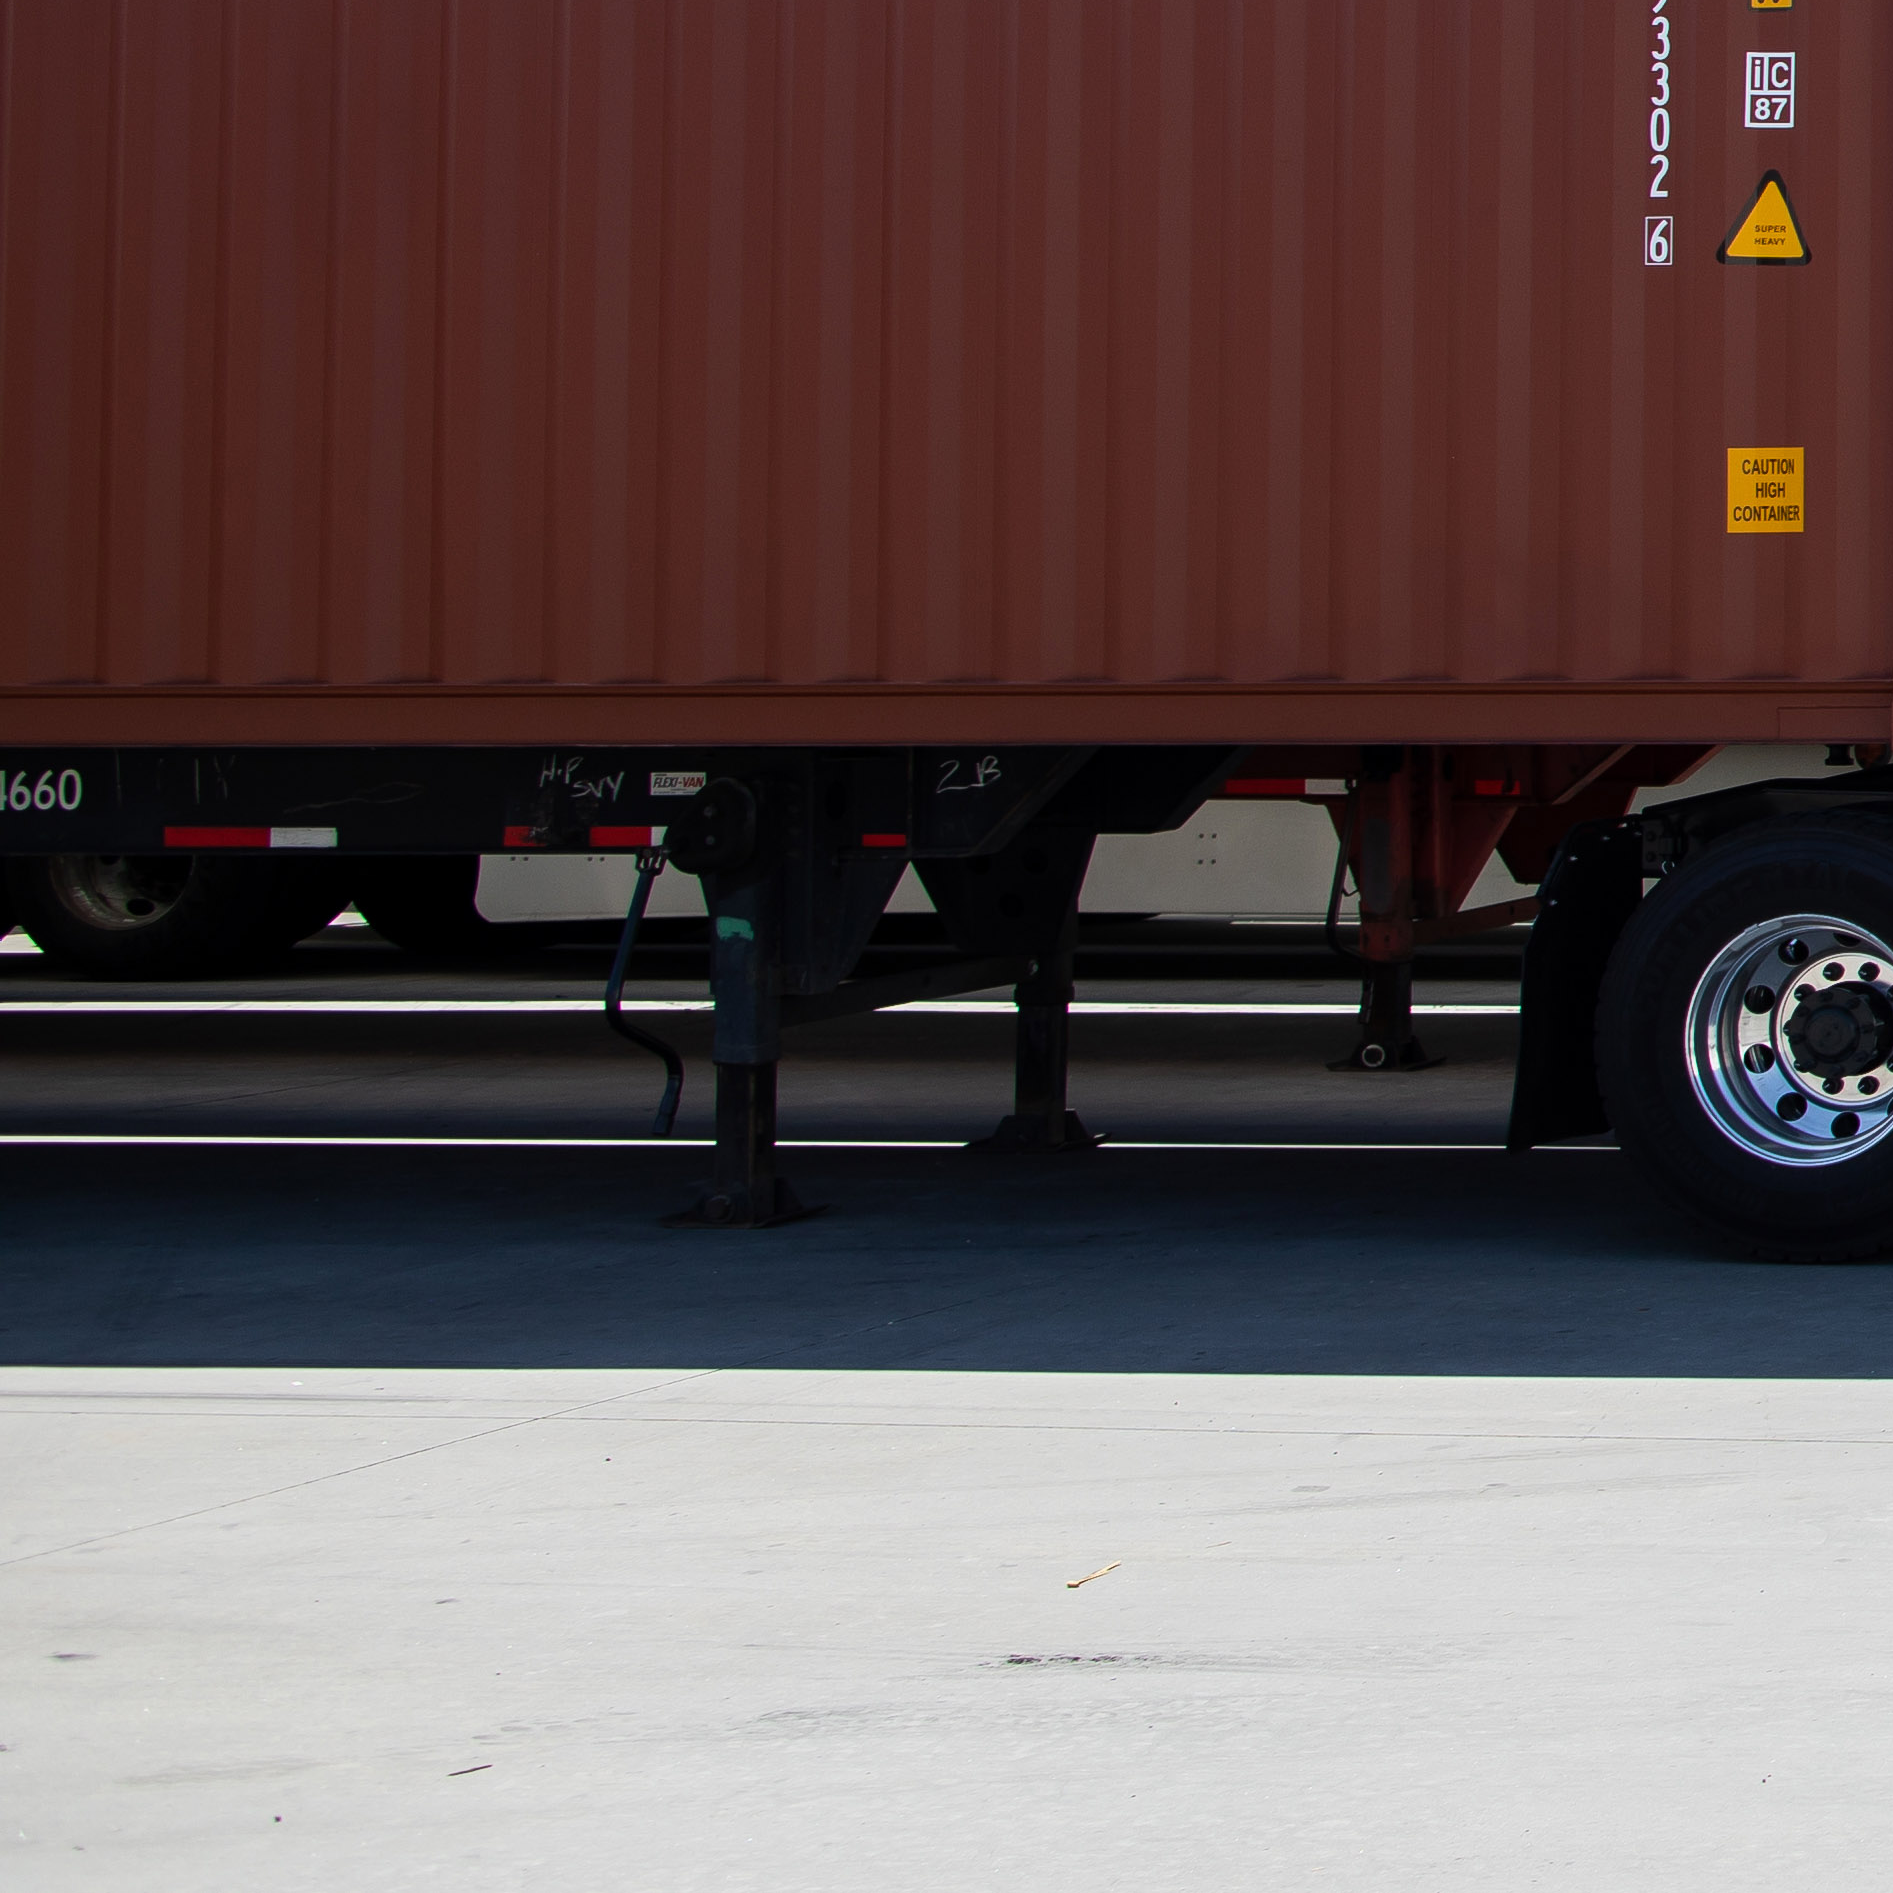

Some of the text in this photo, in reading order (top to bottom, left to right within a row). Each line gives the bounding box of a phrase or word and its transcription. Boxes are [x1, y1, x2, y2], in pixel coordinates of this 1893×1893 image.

[1754, 98, 1788, 121] 87
[1754, 225, 1787, 234] SUPER
[1650, 218, 1669, 263] 6
[1754, 238, 1786, 246] HEAVY
[1741, 458, 1795, 475] CAUTION
[1755, 481, 1786, 499] HIGH
[1733, 504, 1801, 522] CONTAINER
[653, 776, 704, 788] FLEXI-VAN
